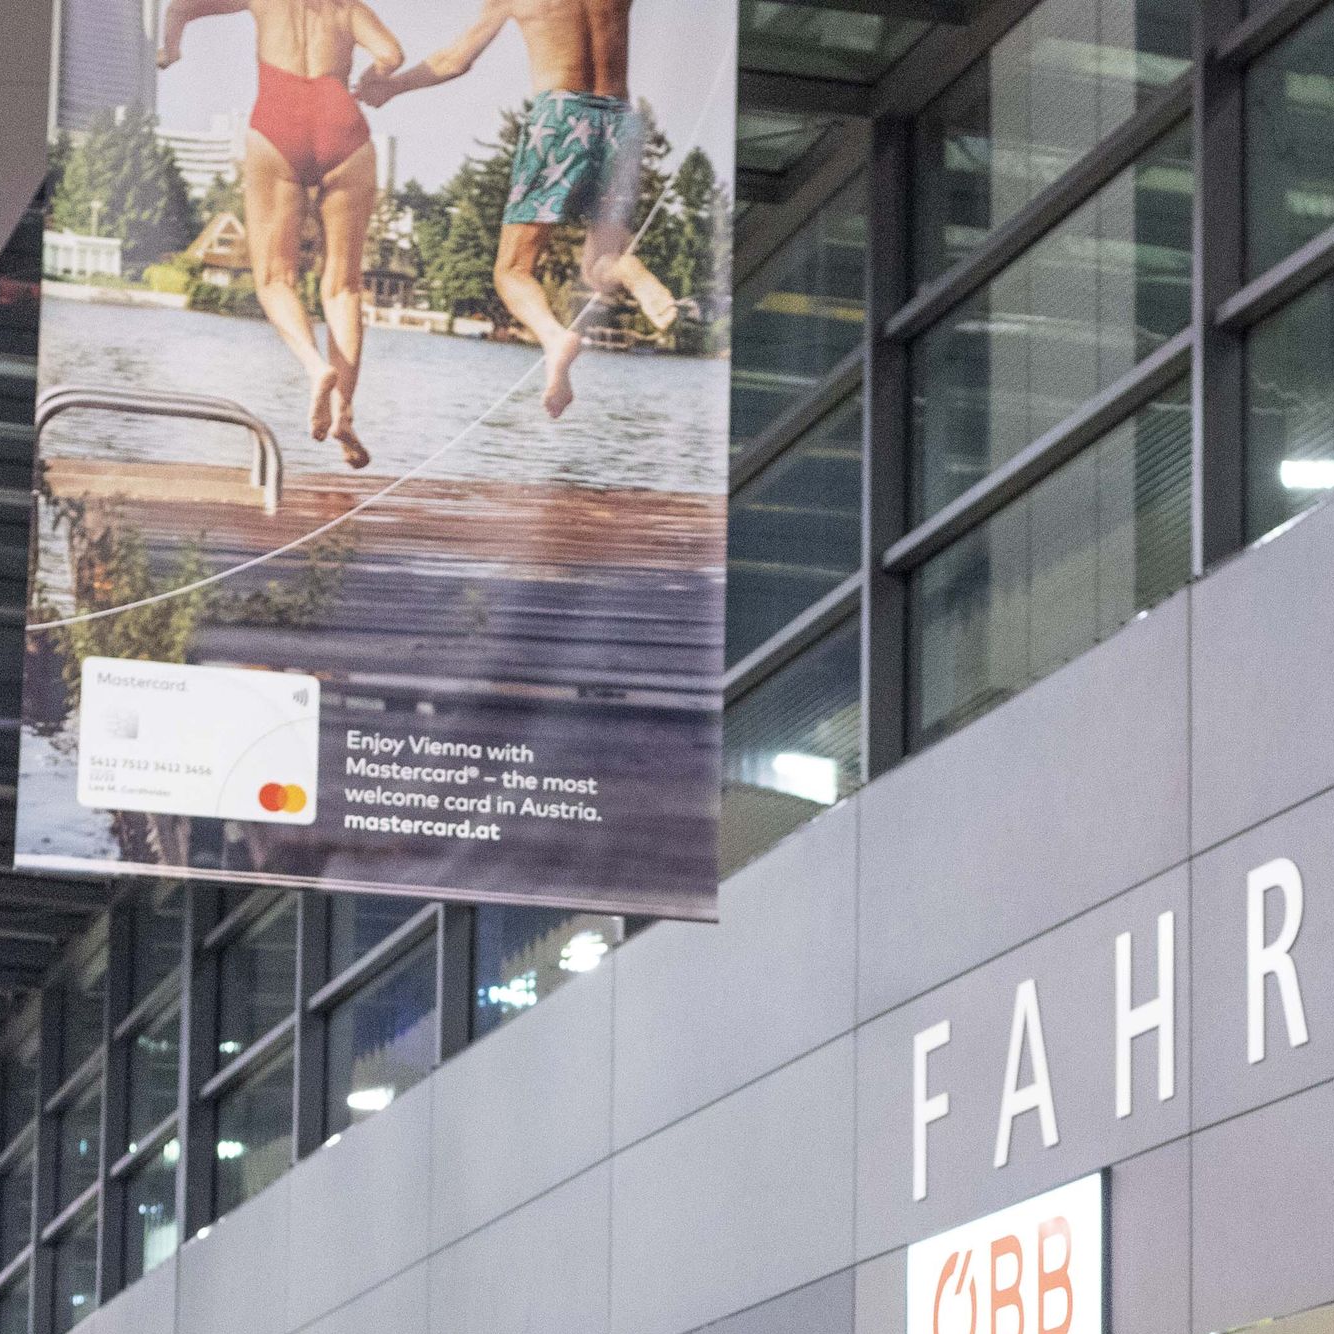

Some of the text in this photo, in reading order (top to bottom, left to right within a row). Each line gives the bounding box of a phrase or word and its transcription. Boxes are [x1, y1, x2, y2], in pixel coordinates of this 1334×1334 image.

[346, 730, 534, 764] Enjoy Vienna with
[89, 756, 118, 769] 5412
[122, 758, 151, 772] 7512
[154, 761, 182, 774] 3412
[185, 764, 214, 777] 3456
[345, 756, 480, 785] Mastercard®
[501, 770, 538, 791] the
[542, 775, 598, 795] most
[344, 786, 603, 822] welcome card in Austria.
[344, 814, 501, 841] mastercard.at
